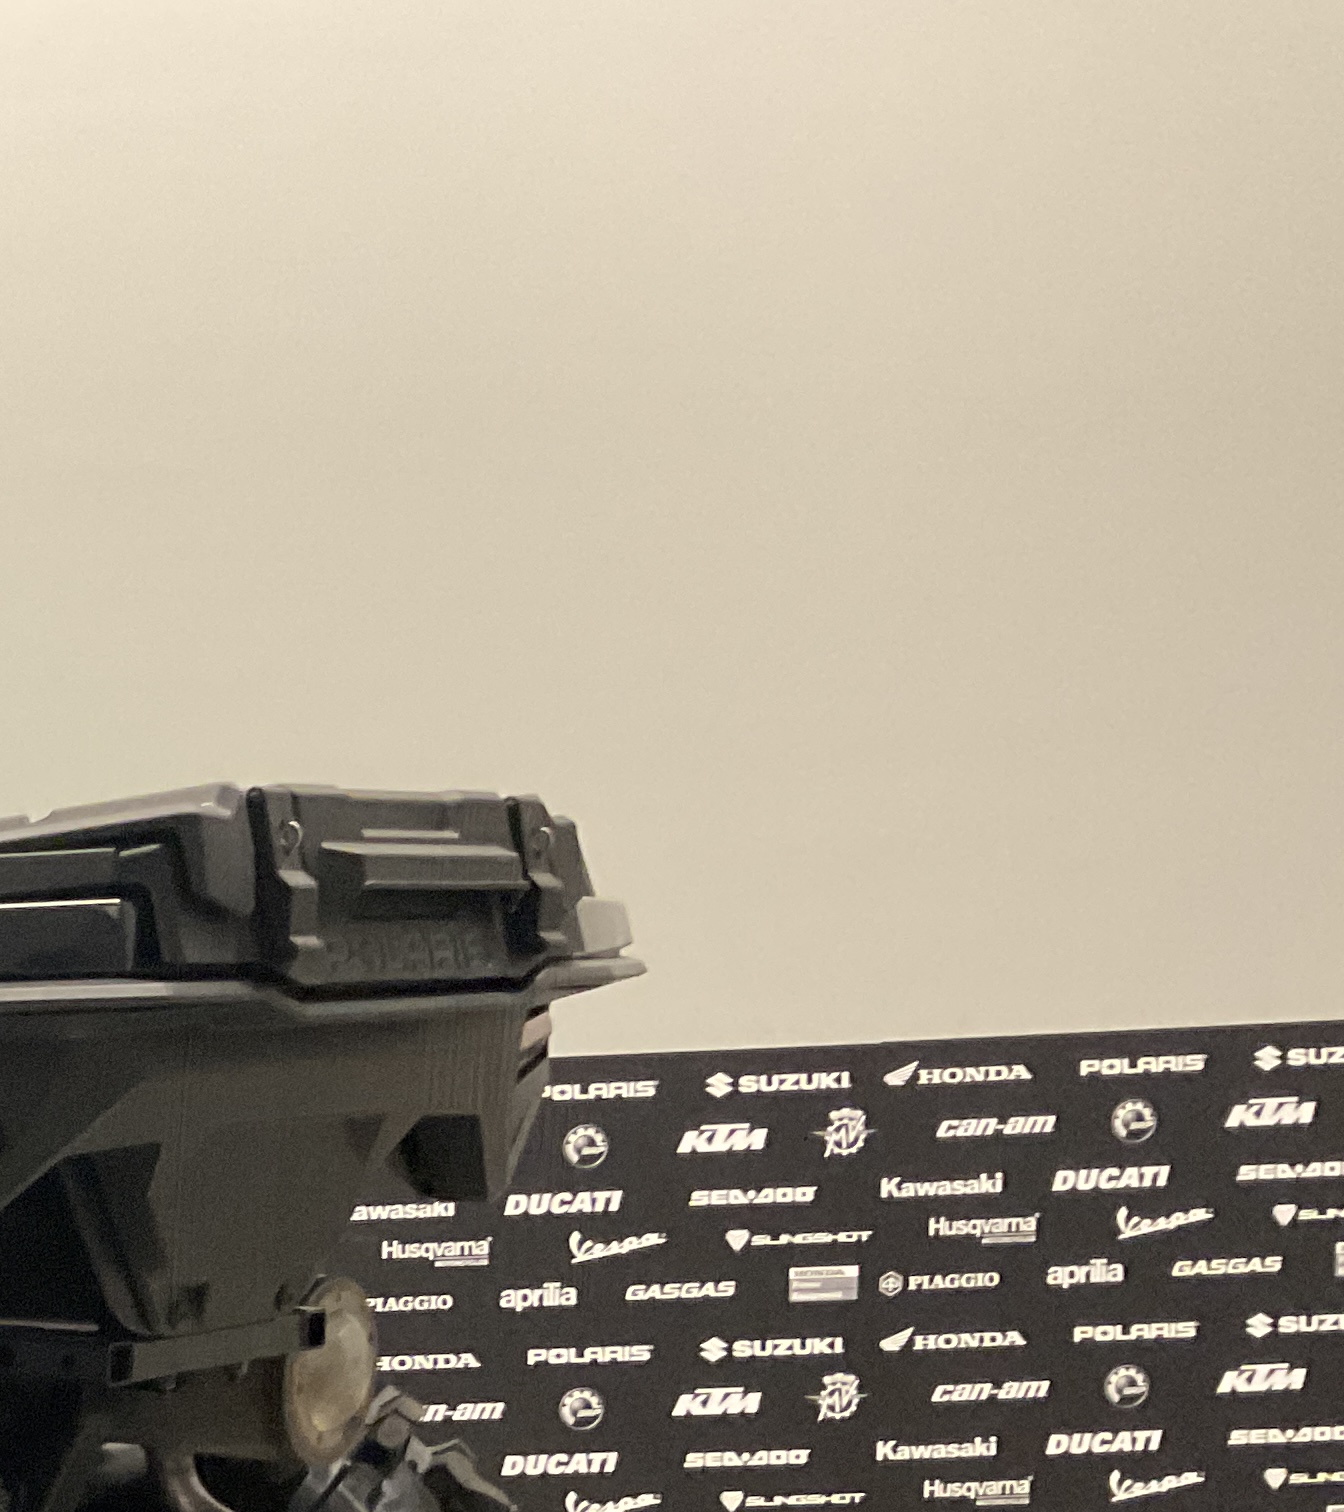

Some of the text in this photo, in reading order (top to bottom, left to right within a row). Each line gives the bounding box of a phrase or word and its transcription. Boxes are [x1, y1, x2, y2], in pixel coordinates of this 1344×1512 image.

[1080, 1054, 1207, 1076] POLARIS
[1286, 1046, 1344, 1066] SUZ
[738, 1071, 852, 1093] SUZUKI
[918, 1064, 1033, 1084] HONDA
[1224, 1096, 1316, 1128] KTM
[676, 1123, 768, 1153] KTM
[936, 1115, 1056, 1138] can-am
[880, 1172, 1003, 1198] Kawasaki
[1051, 1165, 1171, 1191] DUCATI
[350, 1201, 455, 1221] awasaki
[504, 1190, 623, 1215] DUCATI
[928, 1214, 1039, 1237] Husqvarna
[1116, 1206, 1214, 1240] Vespa
[381, 1238, 492, 1260] Husqvarna
[569, 1231, 667, 1264] Vespa
[751, 1231, 873, 1246] SLINGSHOT
[1046, 1258, 1124, 1289] aprilia
[1171, 1256, 1283, 1276] GASGAS
[625, 1281, 736, 1300] GASGAS
[908, 1272, 1000, 1290] PIAGGIO
[499, 1282, 578, 1312] aprilia
[1073, 1321, 1199, 1342] POLARIS
[1278, 1314, 1344, 1333] SUZ
[732, 1337, 845, 1357] SUZUKI
[912, 1327, 1027, 1350] HONDA
[527, 1345, 654, 1365] POLARIS
[1216, 1363, 1307, 1394] KTM
[672, 1387, 762, 1416] KTM
[931, 1380, 1050, 1402] can-am
[876, 1436, 997, 1461] Kawasaki
[1045, 1430, 1163, 1455] DUCATI
[501, 1452, 619, 1476] DUCATI
[923, 1476, 1032, 1499] Husqvarna
[1109, 1469, 1205, 1502] Vespa
[745, 1493, 866, 1507] SLINGSHOT
